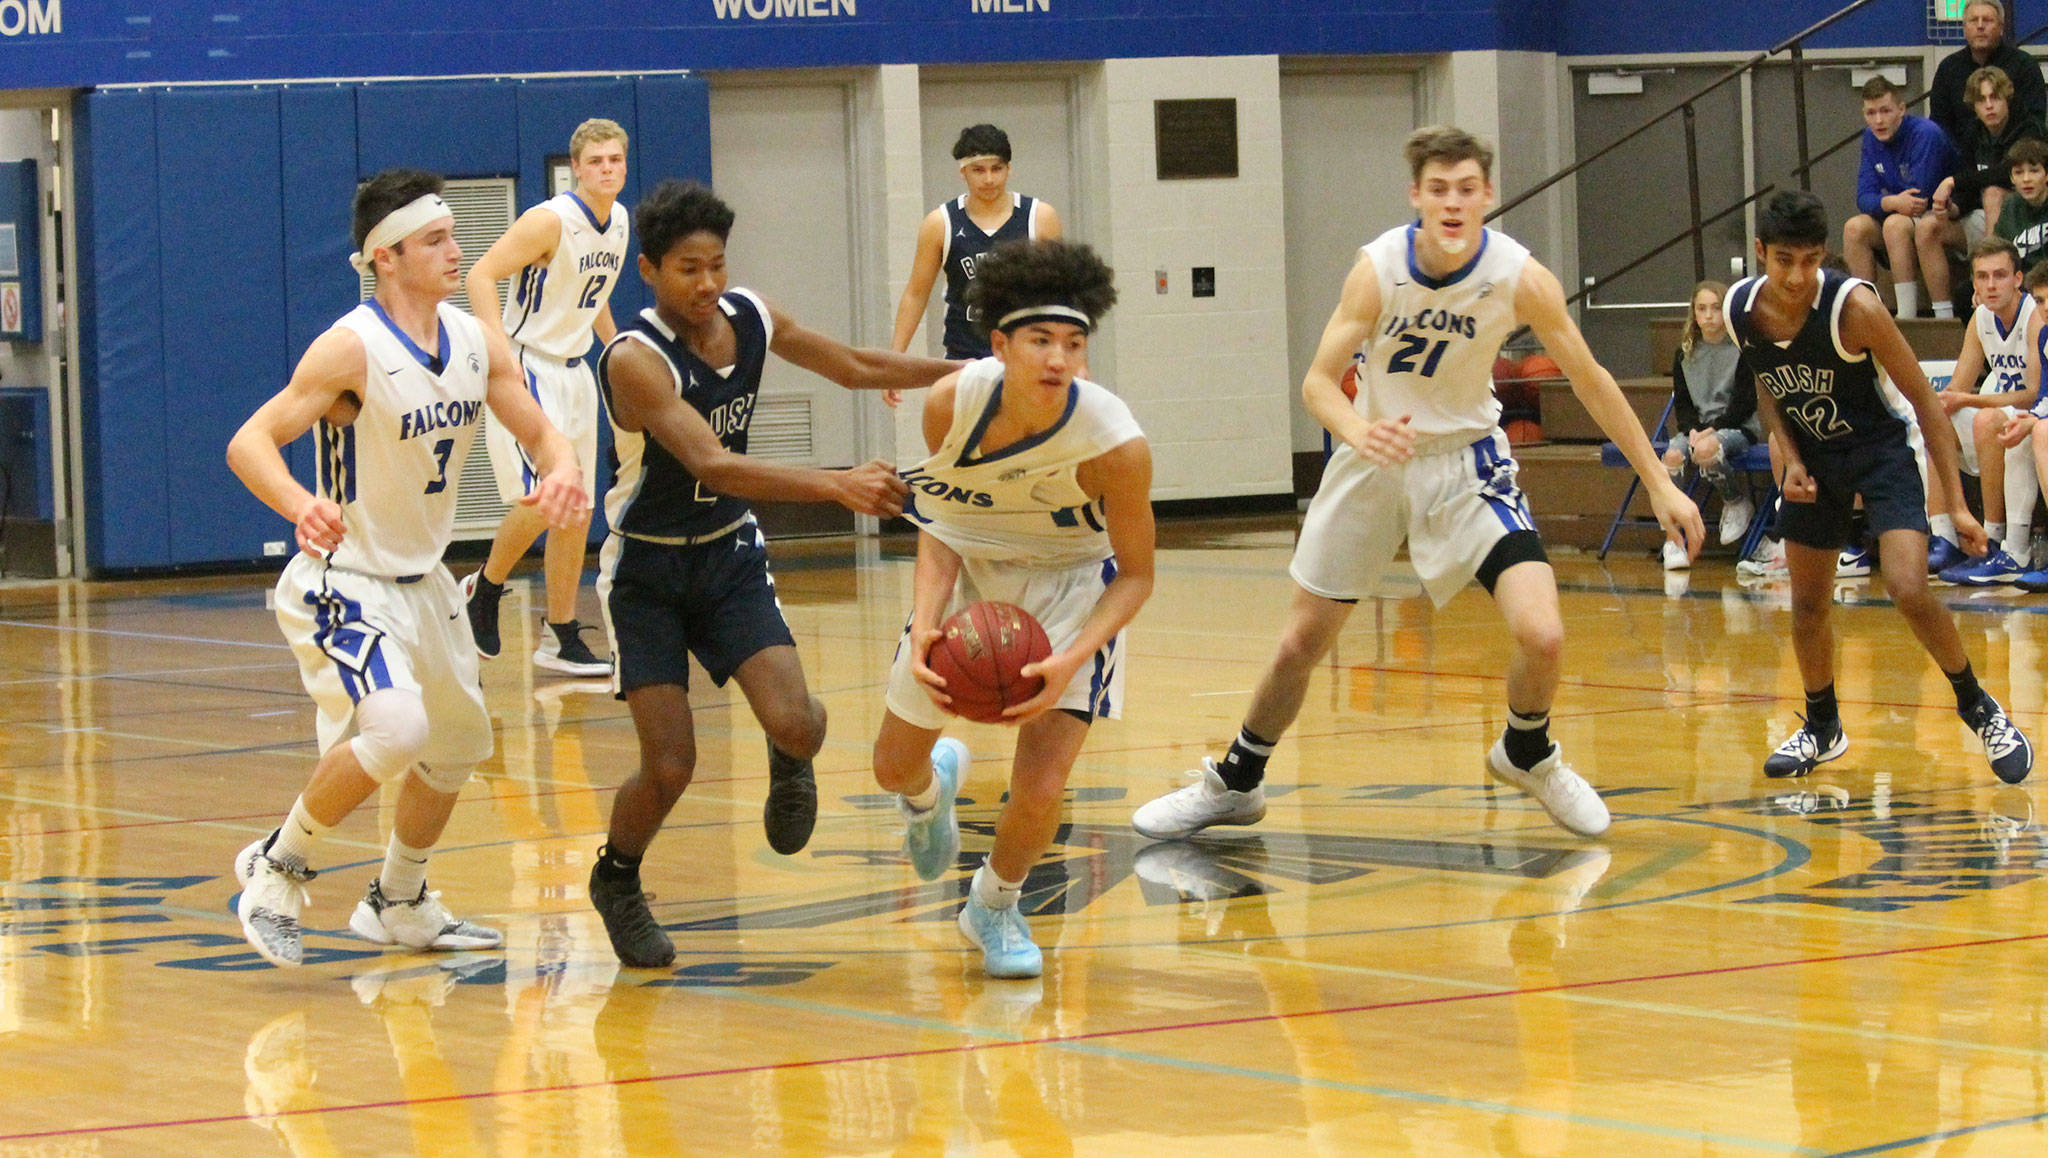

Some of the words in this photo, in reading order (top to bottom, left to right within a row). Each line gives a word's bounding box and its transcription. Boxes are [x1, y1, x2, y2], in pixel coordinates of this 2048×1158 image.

[713, 0, 856, 19] WOMEN
[579, 251, 619, 273] FALCONS
[577, 275, 607, 308] 12
[1387, 333, 1450, 377] 21
[1759, 364, 1835, 399] BUSH
[1786, 395, 1854, 440] 12
[424, 438, 454, 494] 3
